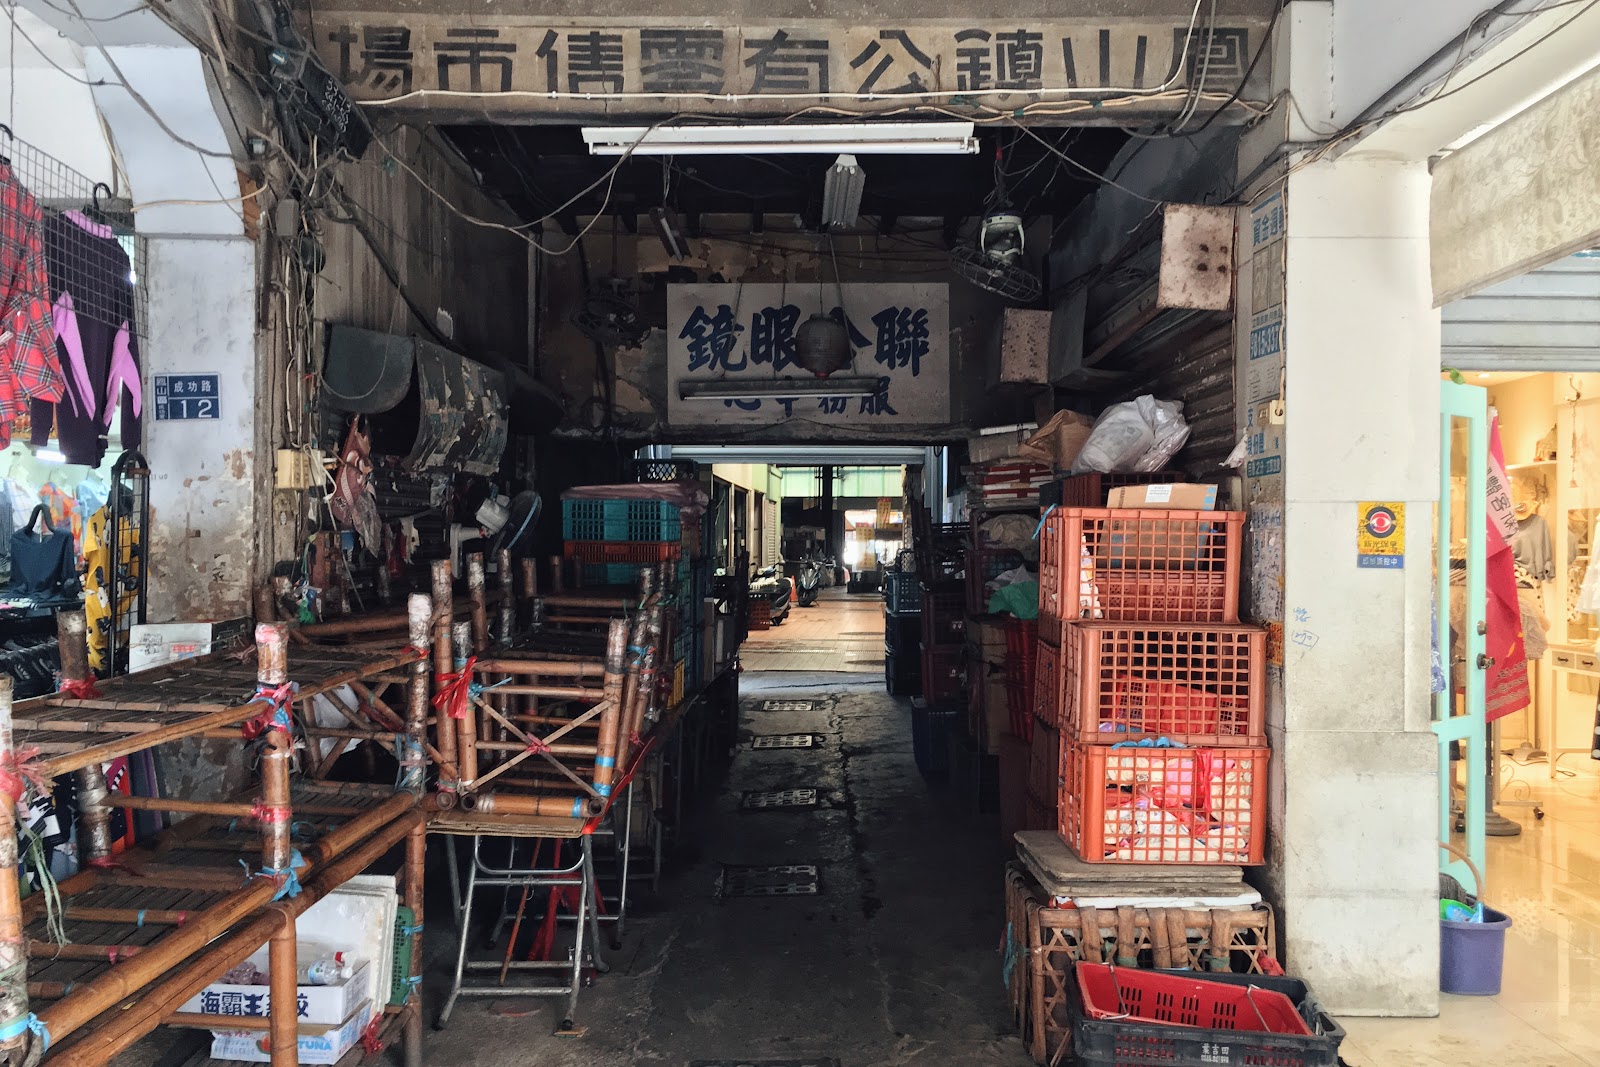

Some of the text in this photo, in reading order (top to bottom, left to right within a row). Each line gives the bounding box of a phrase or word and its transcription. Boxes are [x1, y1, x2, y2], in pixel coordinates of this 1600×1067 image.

[173, 380, 212, 393] 成功路
[180, 399, 213, 419] 12
[201, 991, 309, 1018] 海霸王
